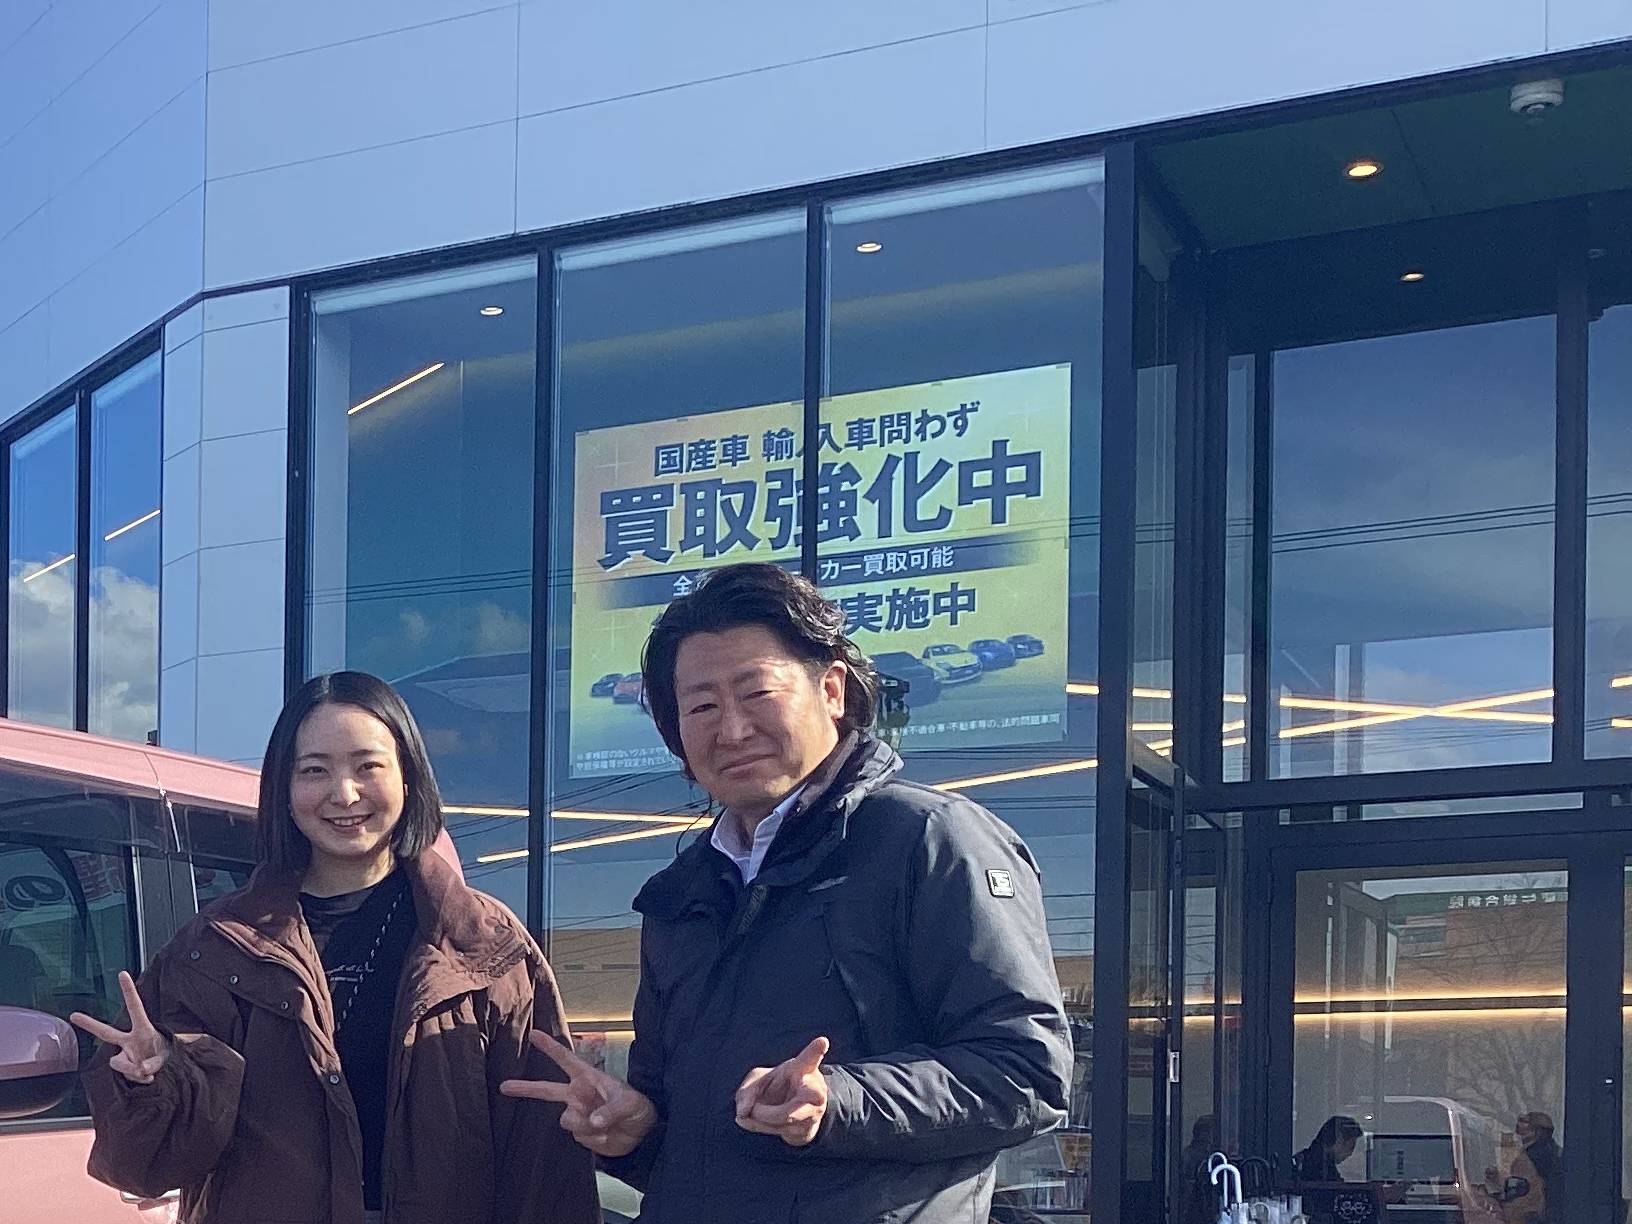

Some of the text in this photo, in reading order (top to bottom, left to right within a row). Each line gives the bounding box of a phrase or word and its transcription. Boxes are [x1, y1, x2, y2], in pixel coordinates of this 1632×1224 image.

[655, 401, 981, 477] 国産車 輸入車問わず
[598, 439, 1041, 569] 買取強化中
